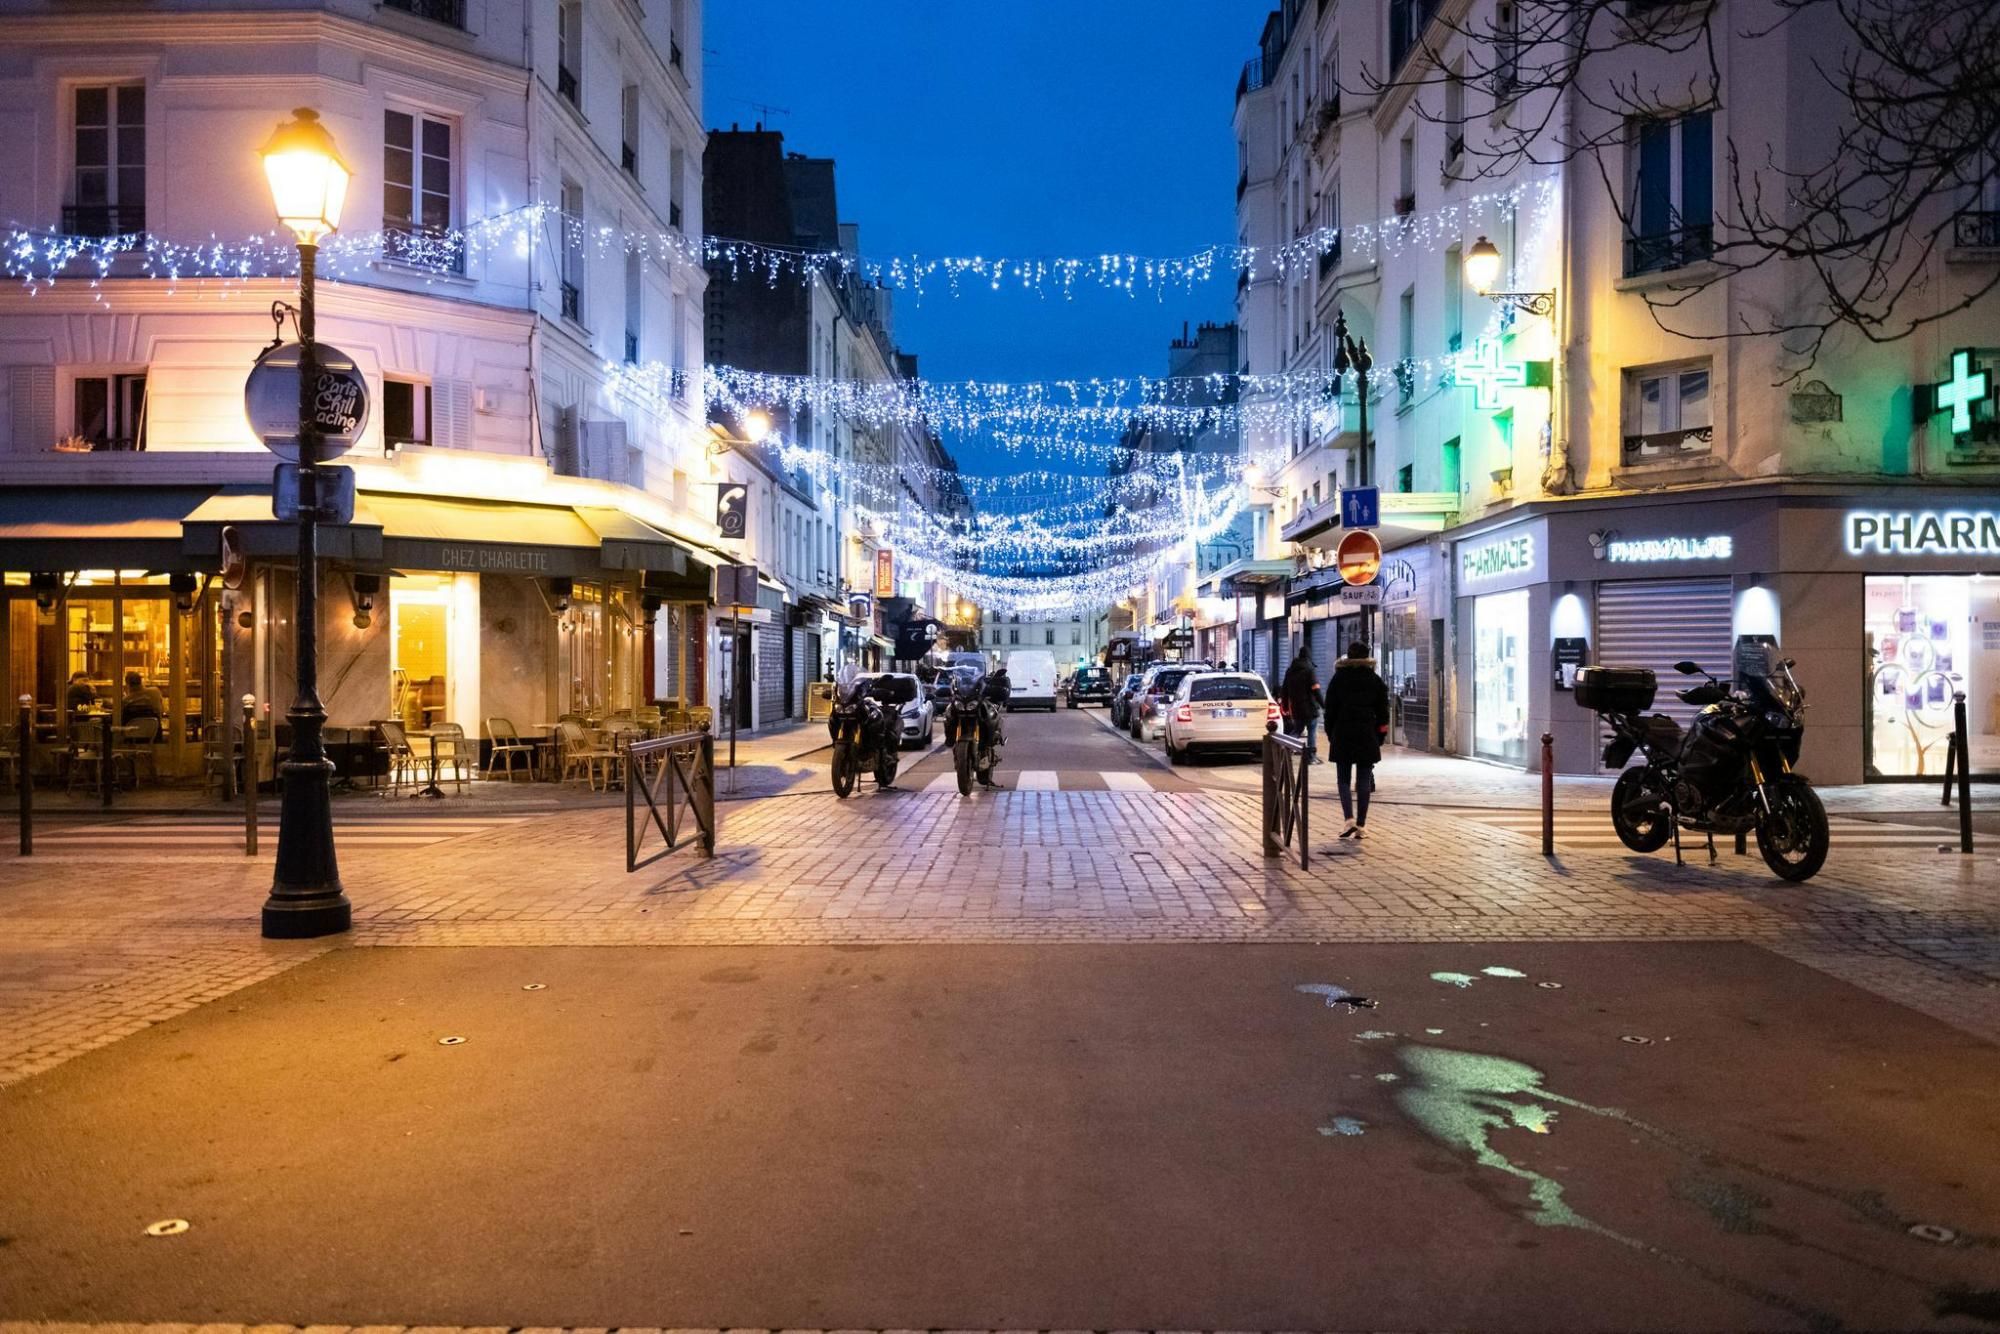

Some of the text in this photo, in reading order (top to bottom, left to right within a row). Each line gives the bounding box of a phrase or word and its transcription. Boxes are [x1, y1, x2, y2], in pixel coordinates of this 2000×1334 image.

[315, 391, 356, 415] Chill
[314, 410, 357, 434] acing
[441, 548, 548, 571] CHEZ CHARLETTE
[1463, 537, 1529, 580] PHARMACIE
[1342, 591, 1364, 600] SAUF
